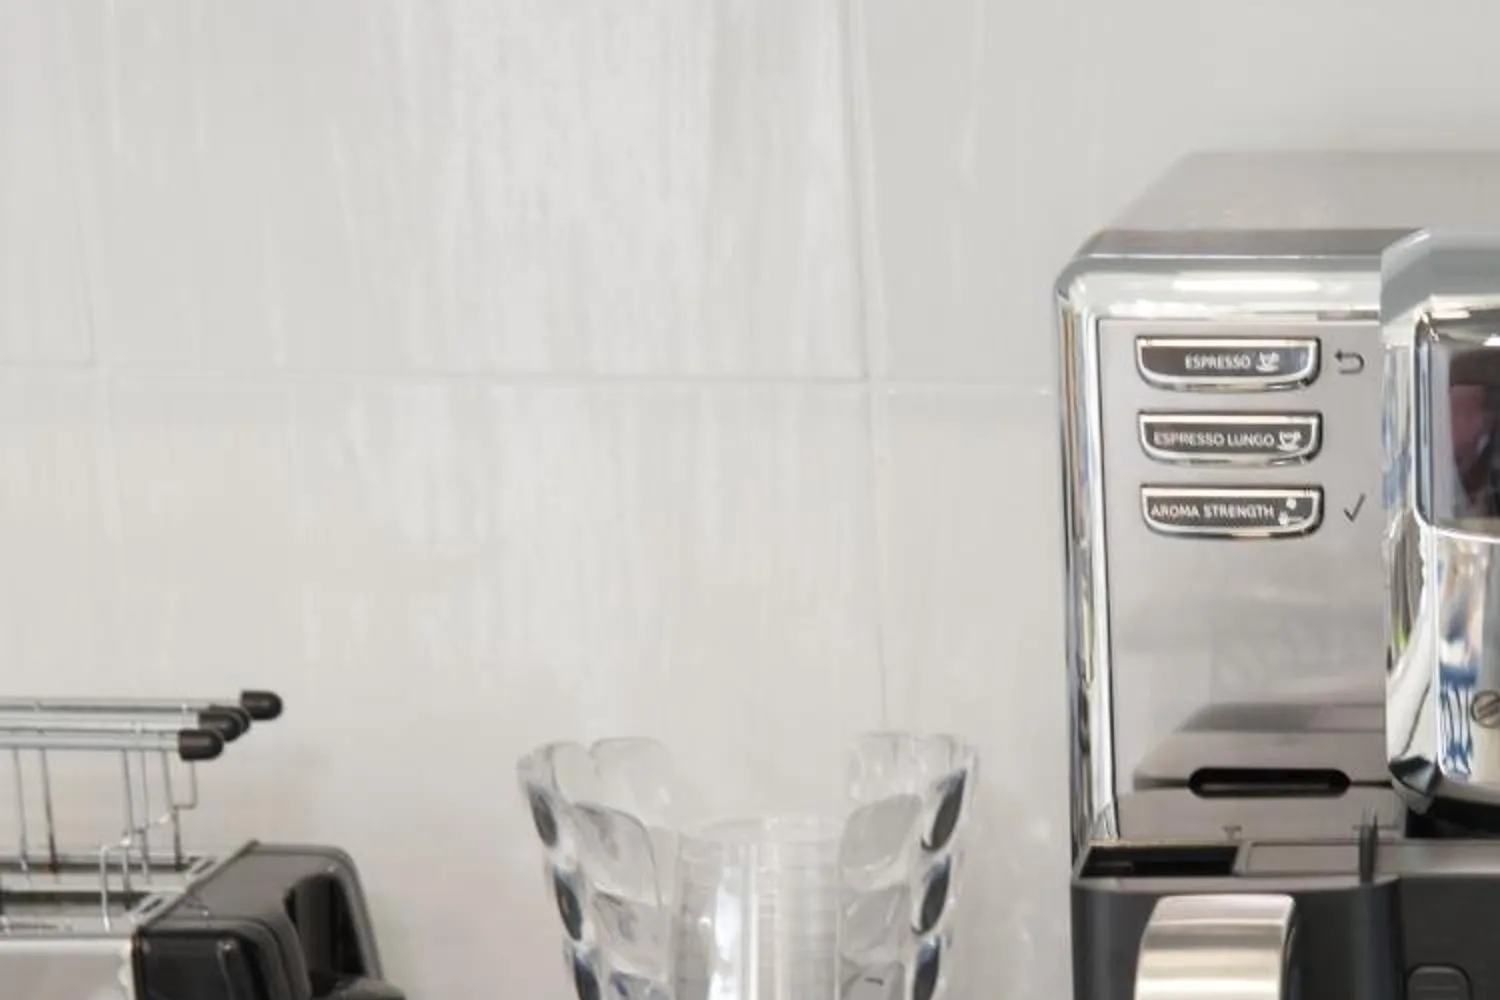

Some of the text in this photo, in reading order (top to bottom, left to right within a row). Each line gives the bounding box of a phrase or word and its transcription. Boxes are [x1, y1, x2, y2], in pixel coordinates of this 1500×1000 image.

[1184, 352, 1251, 370] ESPRESSO
[1153, 430, 1275, 448] ESPRESSO LUNGO
[1150, 503, 1275, 519] AROMA STRENGTH
